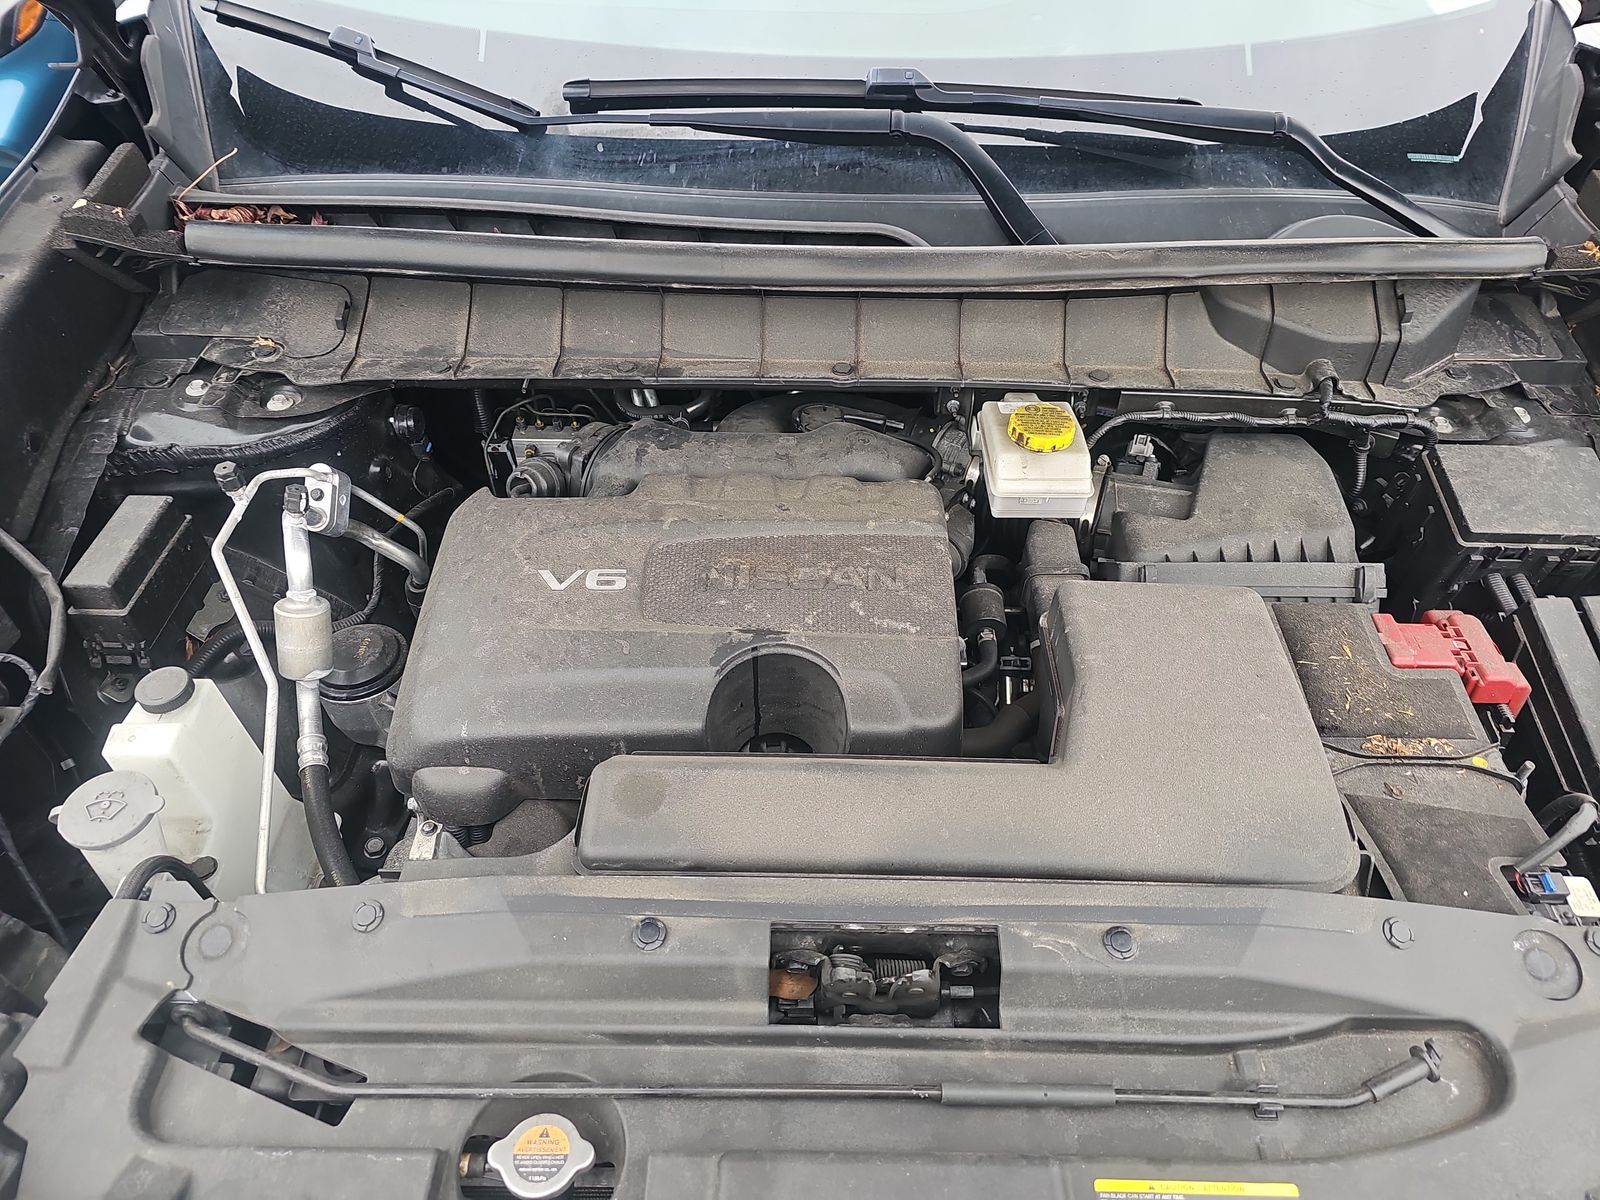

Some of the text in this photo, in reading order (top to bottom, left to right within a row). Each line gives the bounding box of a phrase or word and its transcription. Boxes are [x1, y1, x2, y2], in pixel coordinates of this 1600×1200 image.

[538, 569, 628, 591] V6
[704, 566, 901, 591] NISSAN
[1160, 1183, 1195, 1191] CAUTION
